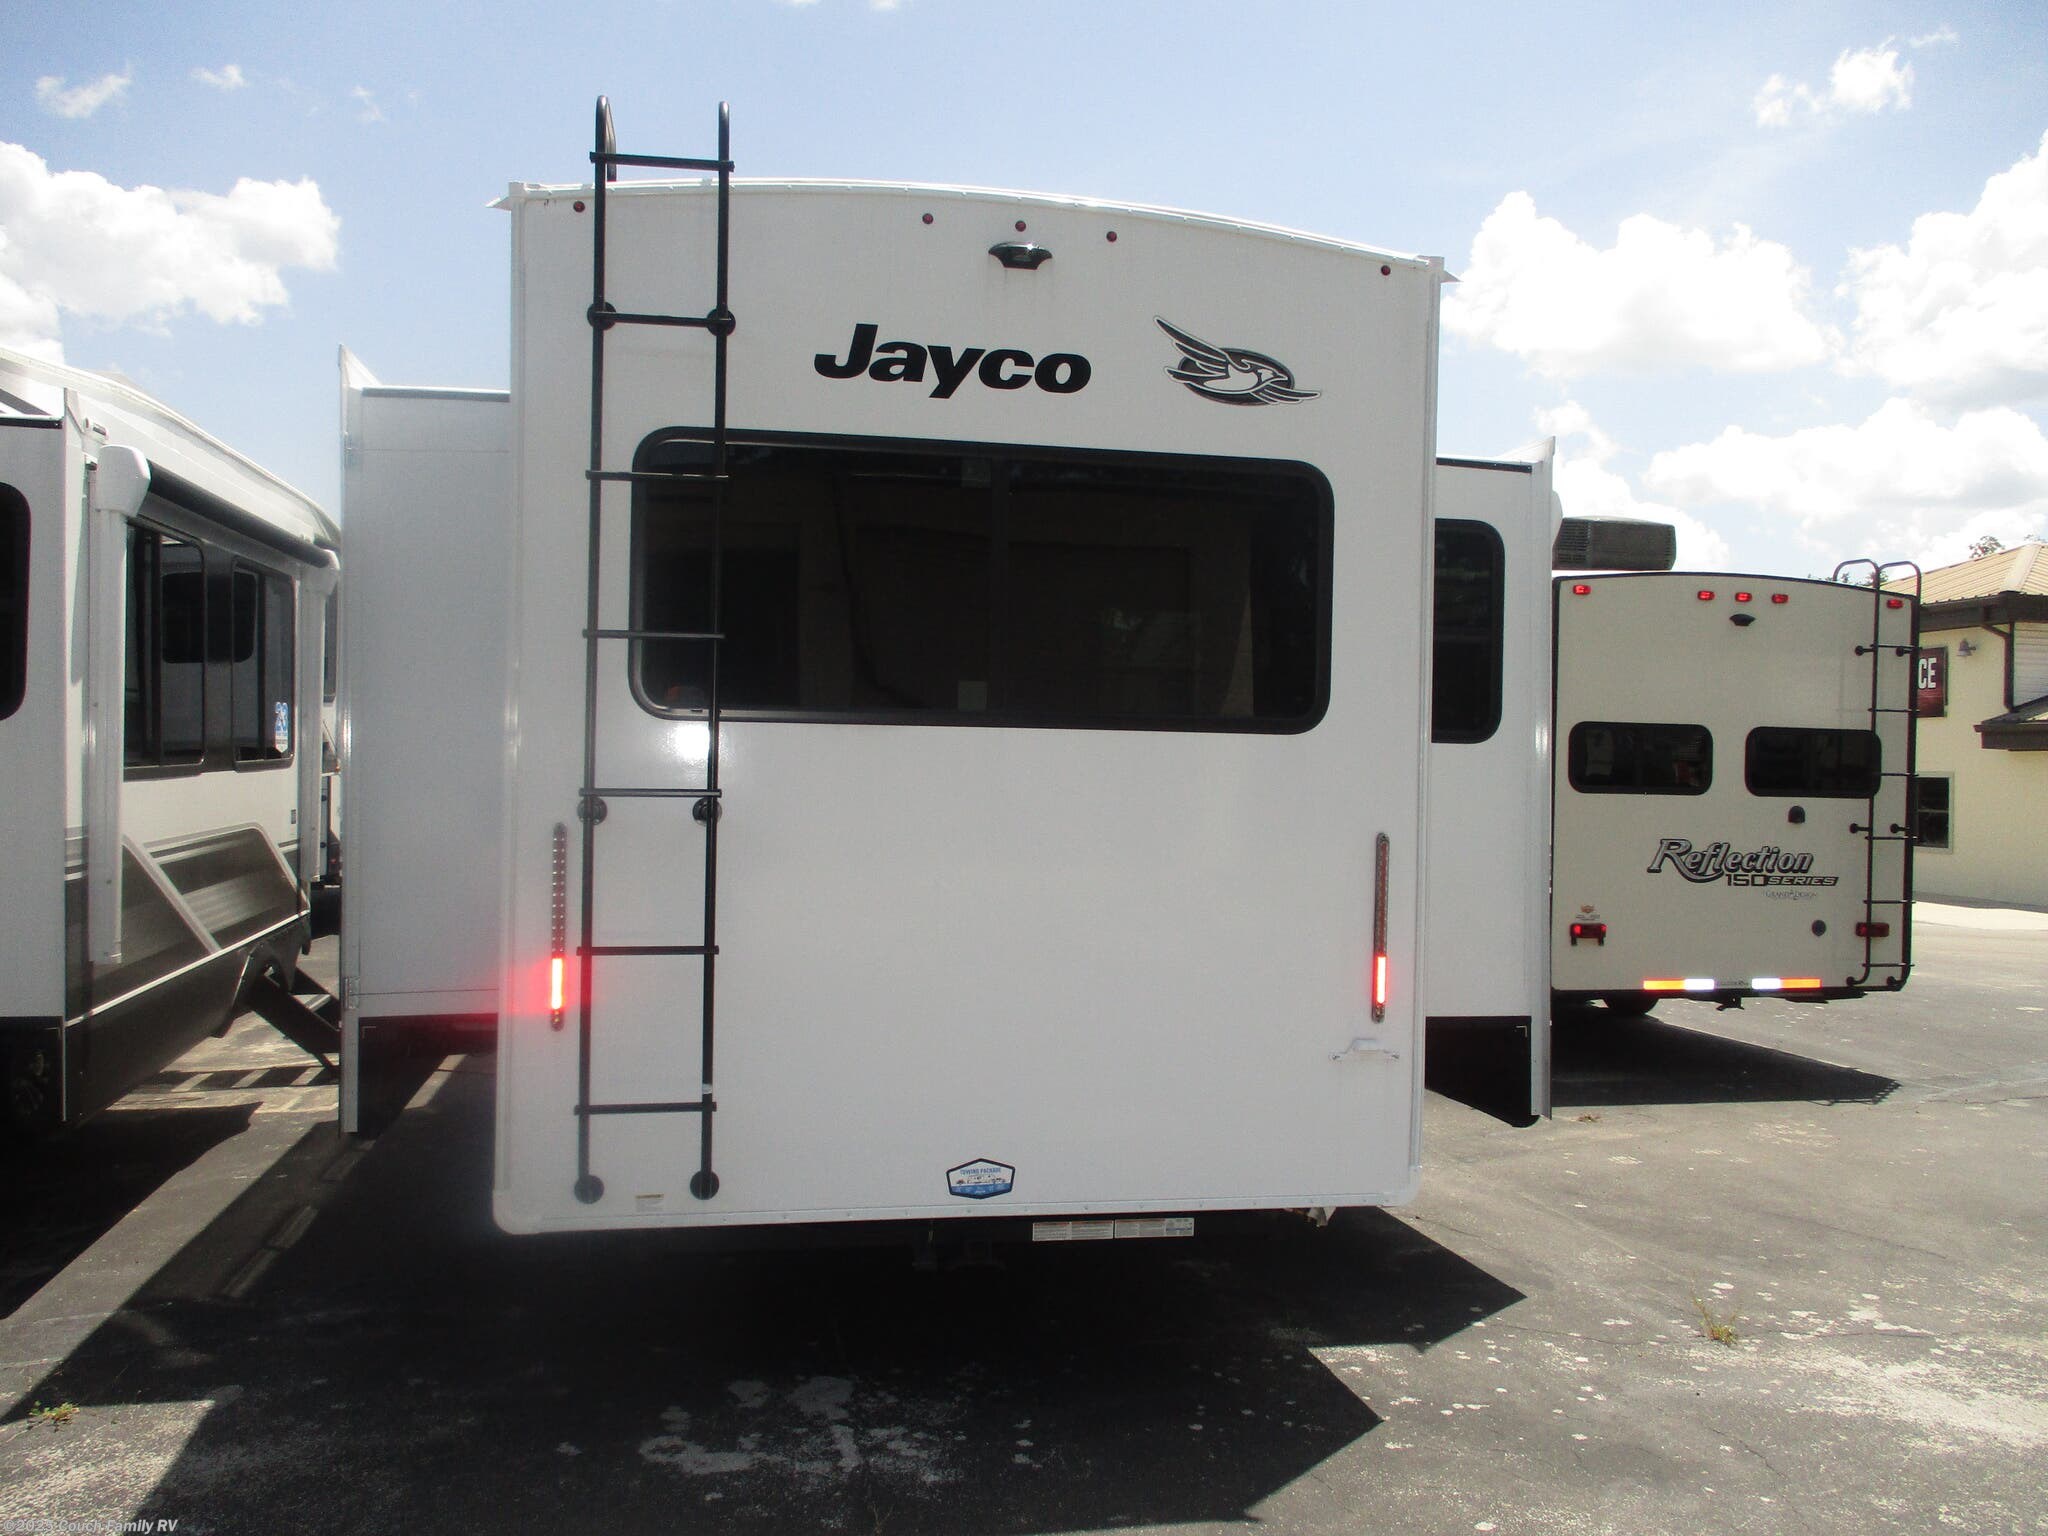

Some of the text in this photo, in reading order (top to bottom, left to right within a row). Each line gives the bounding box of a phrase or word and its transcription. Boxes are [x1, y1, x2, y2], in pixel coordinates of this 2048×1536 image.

[813, 322, 1092, 400] Jayco
[1647, 838, 1814, 884] Reflection
[1725, 874, 1839, 887] 150 SERIES
